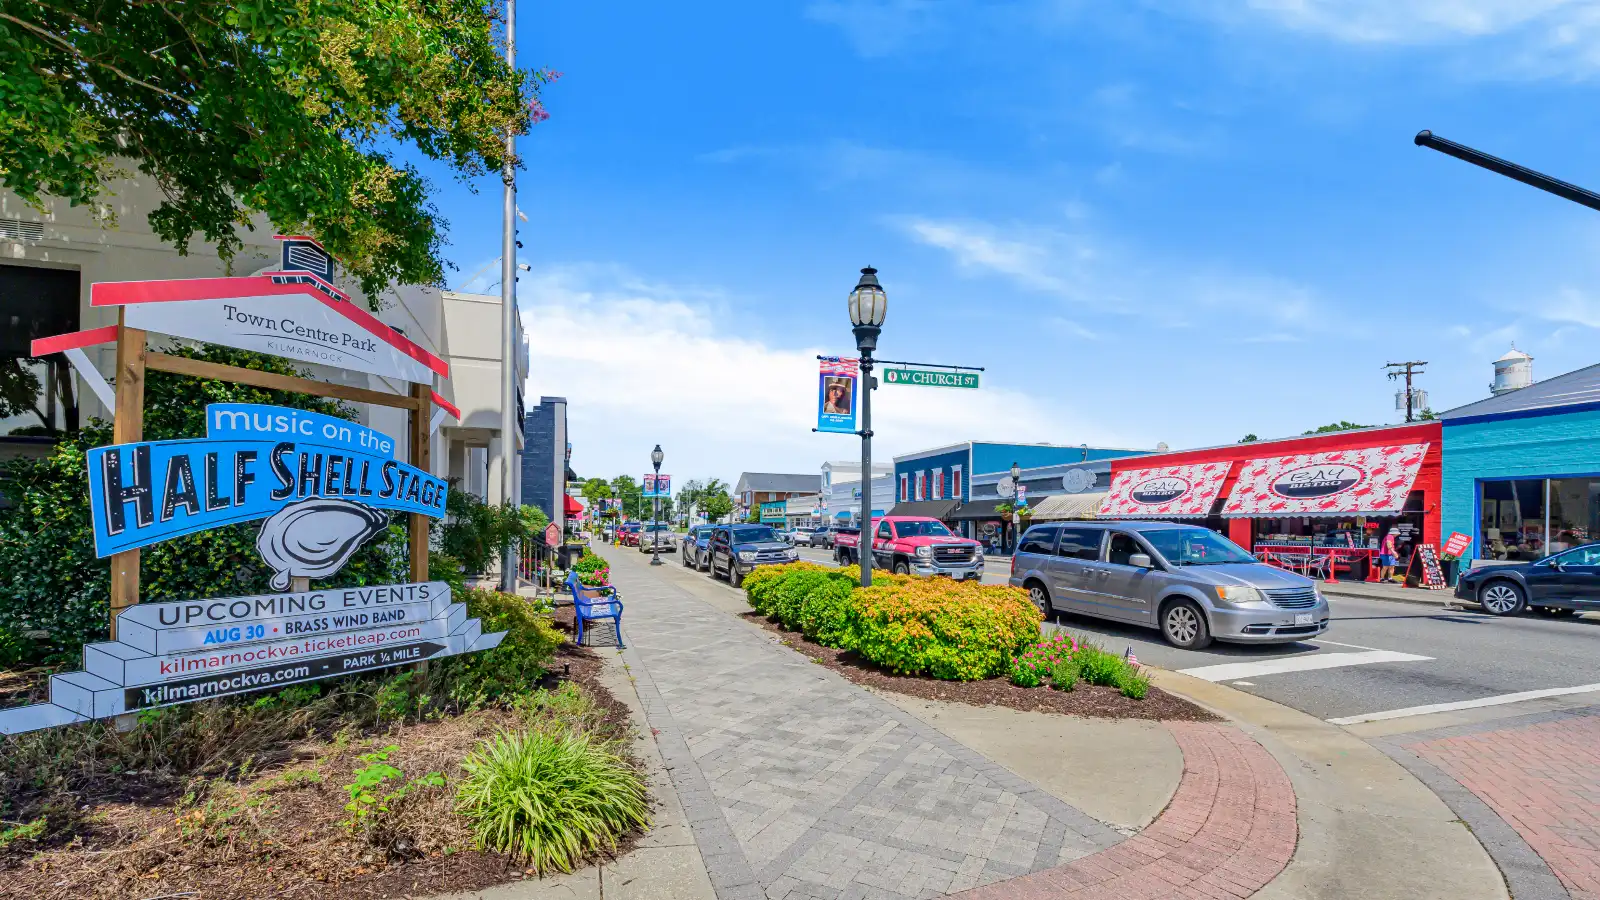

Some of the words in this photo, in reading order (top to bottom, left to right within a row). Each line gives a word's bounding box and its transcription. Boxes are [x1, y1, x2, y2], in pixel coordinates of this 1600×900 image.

[223, 304, 277, 331] Town
[280, 319, 339, 344] Centre
[341, 332, 377, 353] Park
[267, 341, 343, 363] KILMARNOCK
[900, 372, 911, 381] W
[912, 372, 962, 386] CHURCH
[964, 377, 975, 385] ST
[215, 410, 313, 436] music
[322, 423, 351, 443] on
[359, 430, 391, 453] the
[101, 445, 257, 537] HALF
[269, 441, 373, 501] SHELL
[378, 460, 445, 509] STAGE
[1143, 481, 1179, 491] BAY
[1289, 480, 1342, 489] BISTRO
[1290, 468, 1345, 483] BAY
[159, 594, 326, 626] UPCOMING
[343, 585, 430, 607] EVENTS
[203, 627, 241, 645] AUG
[245, 624, 265, 640] 30
[285, 617, 329, 634] BRASS
[333, 613, 368, 628] WIND
[372, 609, 405, 624] BAND
[160, 628, 420, 675] kilmarnockva.ticketleap.com
[144, 666, 309, 704] kilmarnockva.com
[343, 655, 376, 669] PARK
[393, 647, 420, 661] MILE
